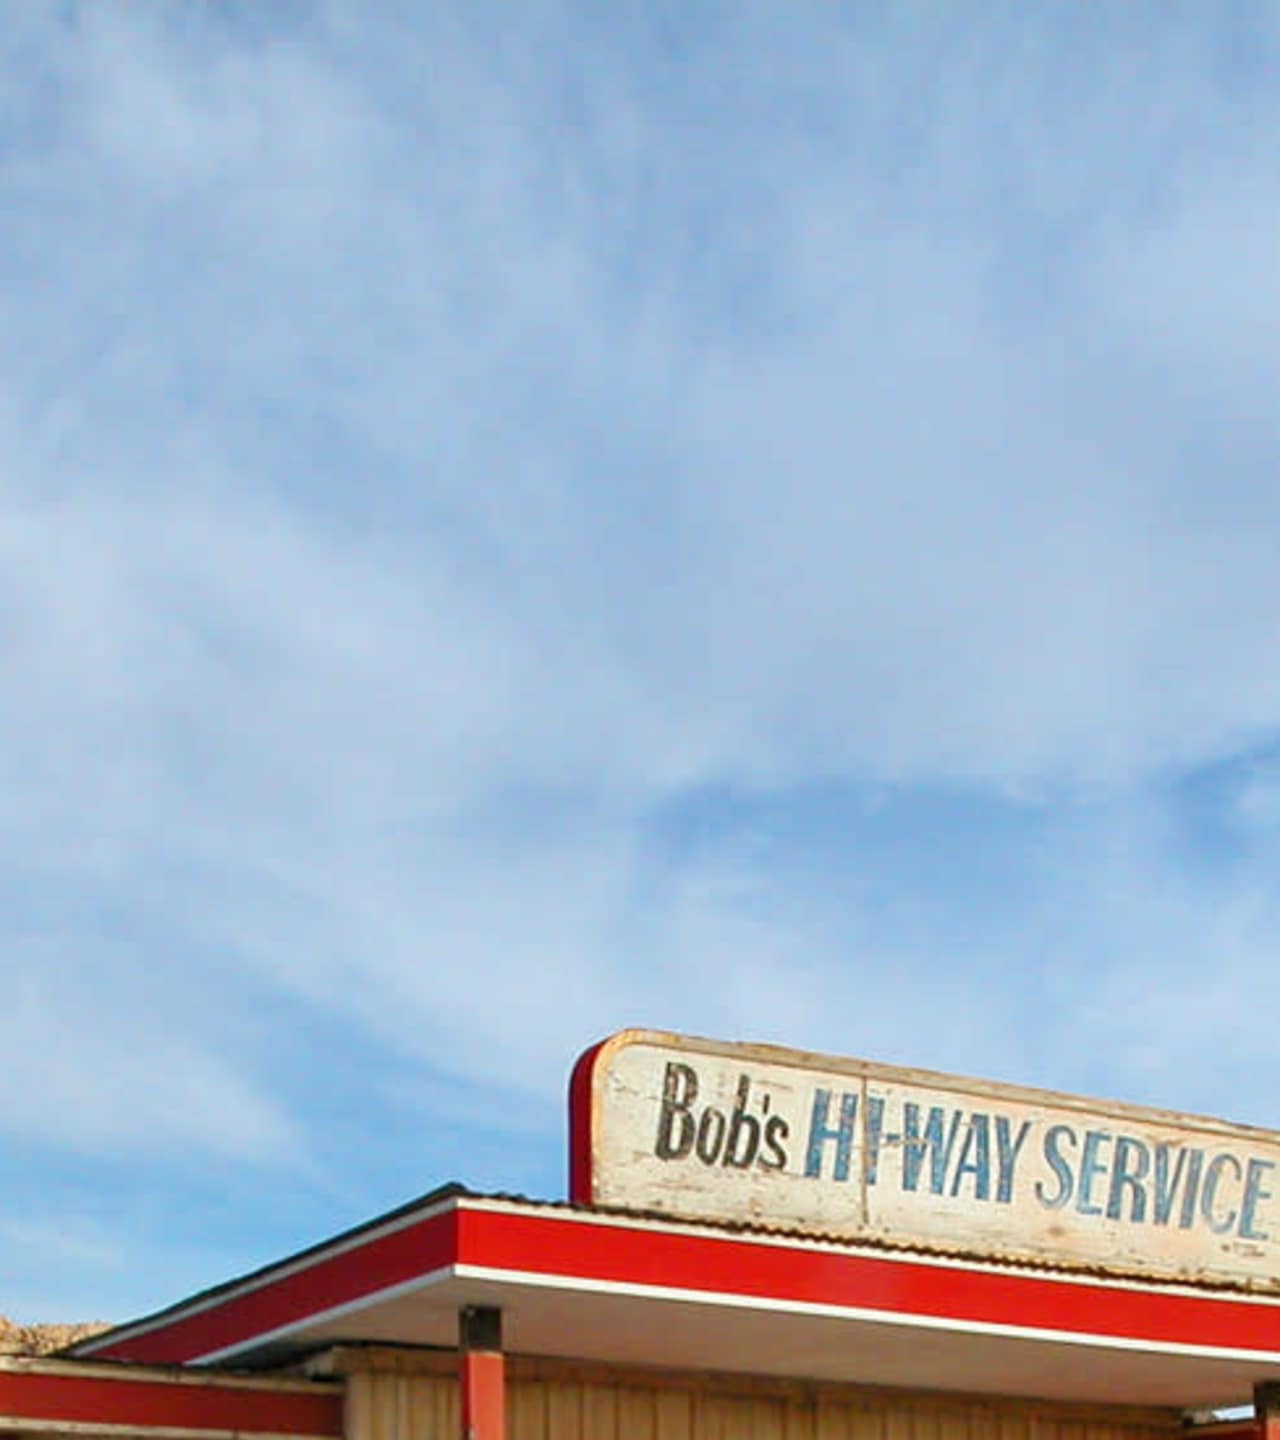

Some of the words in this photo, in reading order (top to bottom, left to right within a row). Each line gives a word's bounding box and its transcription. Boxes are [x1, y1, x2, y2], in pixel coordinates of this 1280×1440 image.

[655, 1061, 790, 1171] Bob's
[803, 1088, 1032, 1204] HI-WAY
[1034, 1124, 1276, 1241] SERVICE
